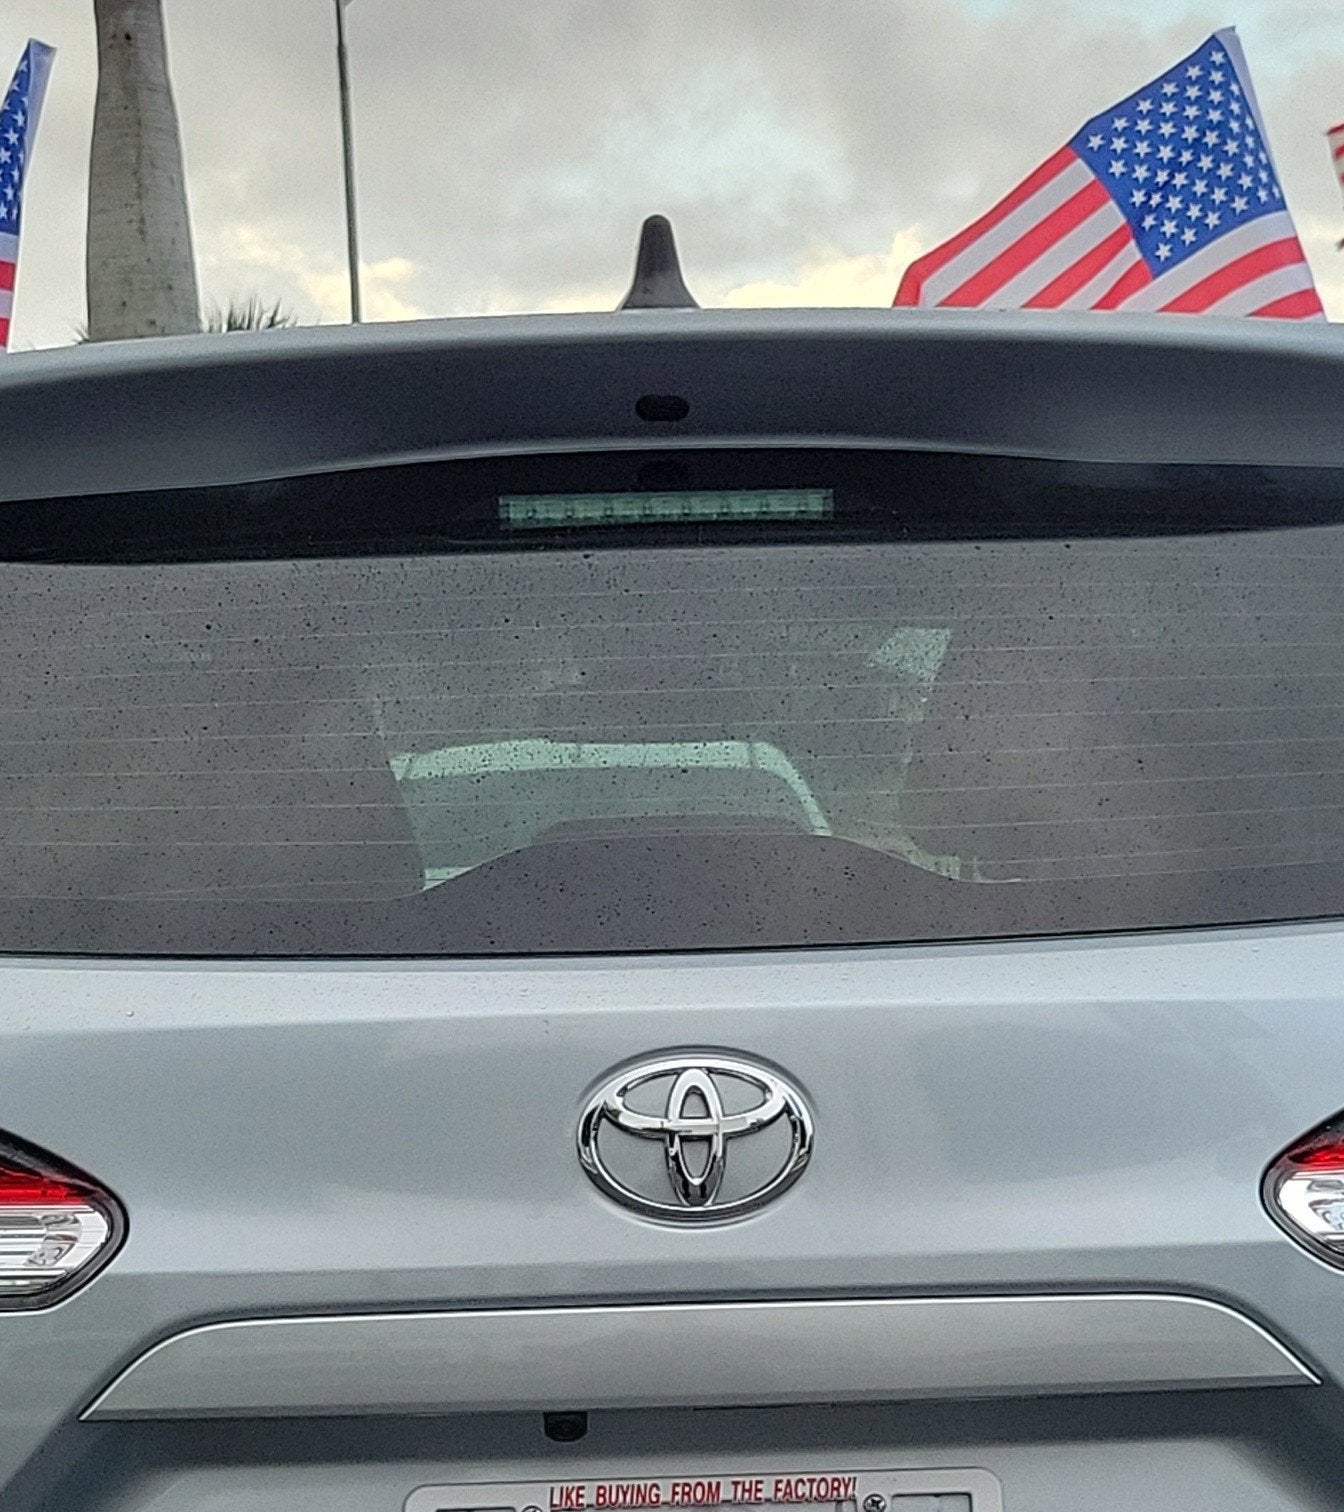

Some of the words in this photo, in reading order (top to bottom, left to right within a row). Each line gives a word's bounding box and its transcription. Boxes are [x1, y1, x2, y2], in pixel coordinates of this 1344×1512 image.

[550, 1485, 586, 1508] LIKE
[596, 1482, 661, 1507] BUYING
[671, 1480, 721, 1505] FROM
[731, 1478, 764, 1502] THE
[774, 1476, 857, 1501] FACTORY!
